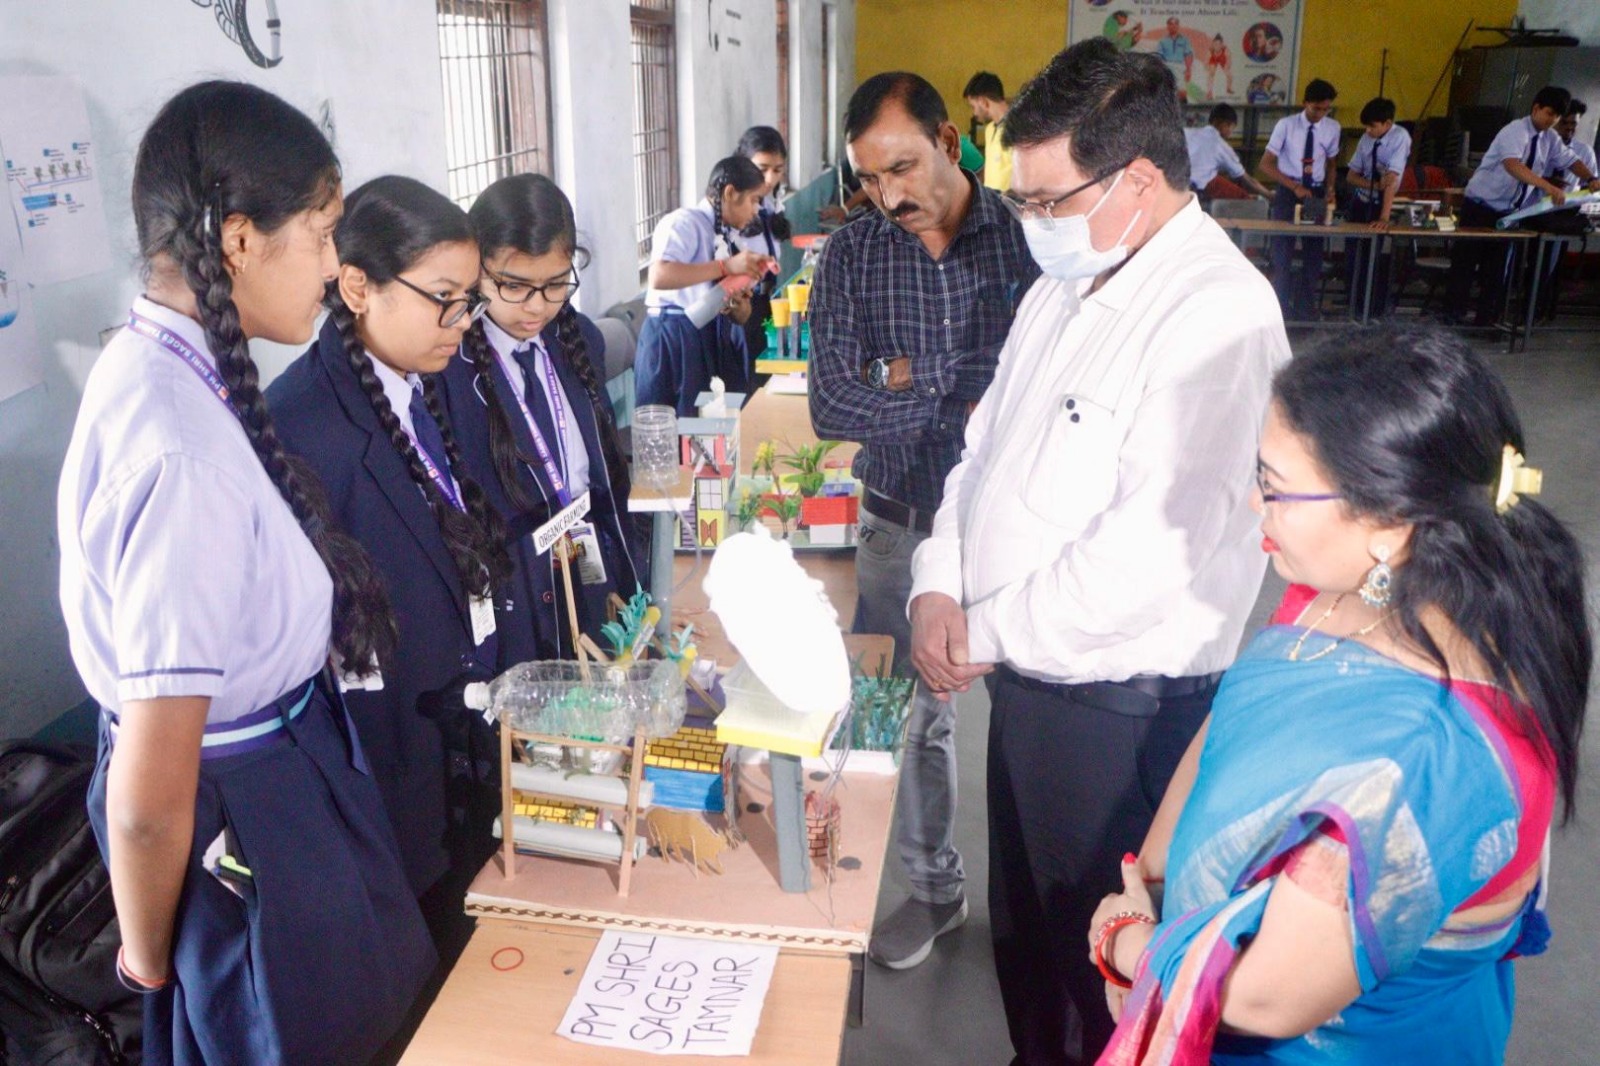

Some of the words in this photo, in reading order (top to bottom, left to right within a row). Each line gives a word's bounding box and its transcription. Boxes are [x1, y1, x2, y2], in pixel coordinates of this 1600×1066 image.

[538, 518, 564, 548] ORGANIC
[594, 936, 657, 997] SHRI
[570, 1002, 625, 1040] PM
[629, 960, 699, 1050] SAGES
[682, 956, 760, 1049] TAMNAR
